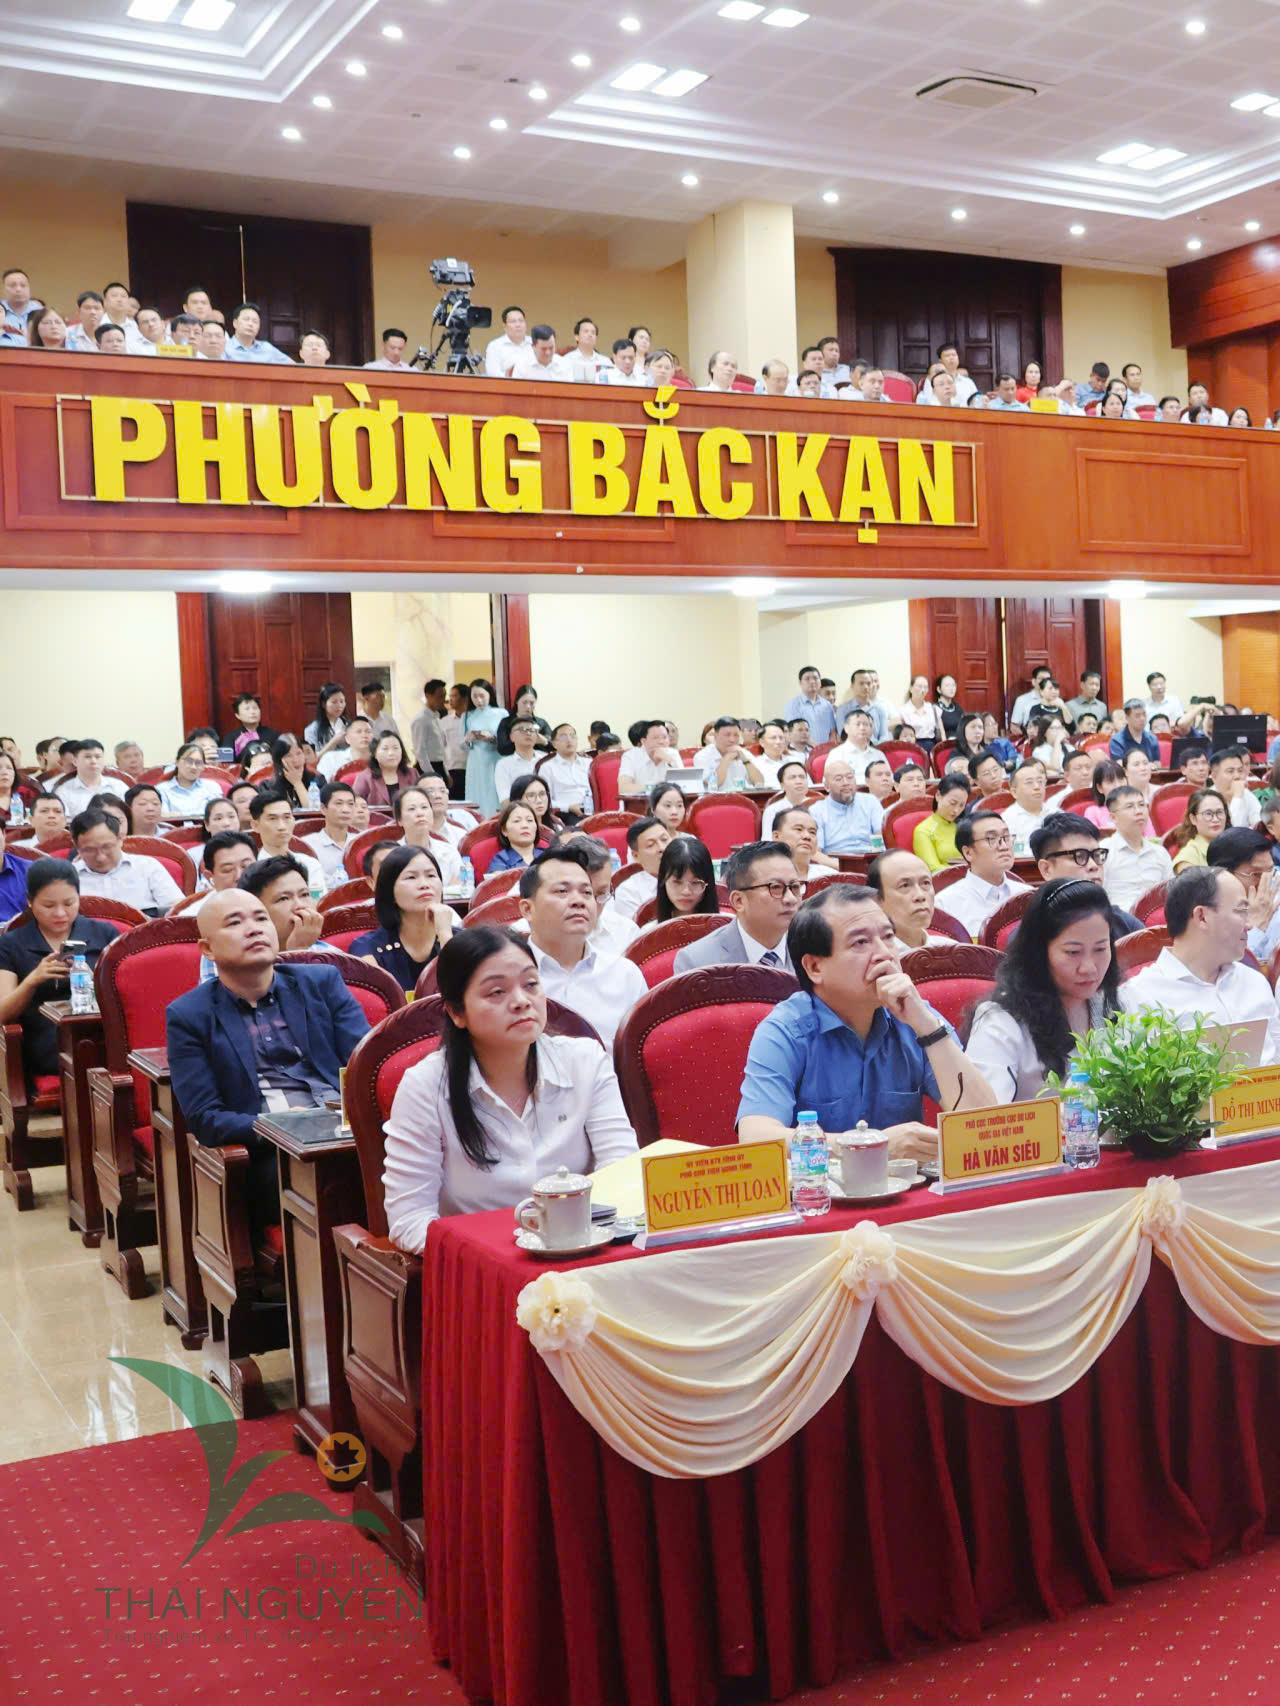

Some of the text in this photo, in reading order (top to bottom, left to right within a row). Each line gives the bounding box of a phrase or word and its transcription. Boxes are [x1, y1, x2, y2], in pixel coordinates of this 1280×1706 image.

[90, 382, 956, 545] PHƯỜNG BẮC KẠN
[1257, 1097, 1280, 1115] MINH
[963, 1139, 1040, 1171] HÀ VĂN SIÊU
[715, 1183, 741, 1208] THỊ
[744, 1177, 782, 1202] LOAN
